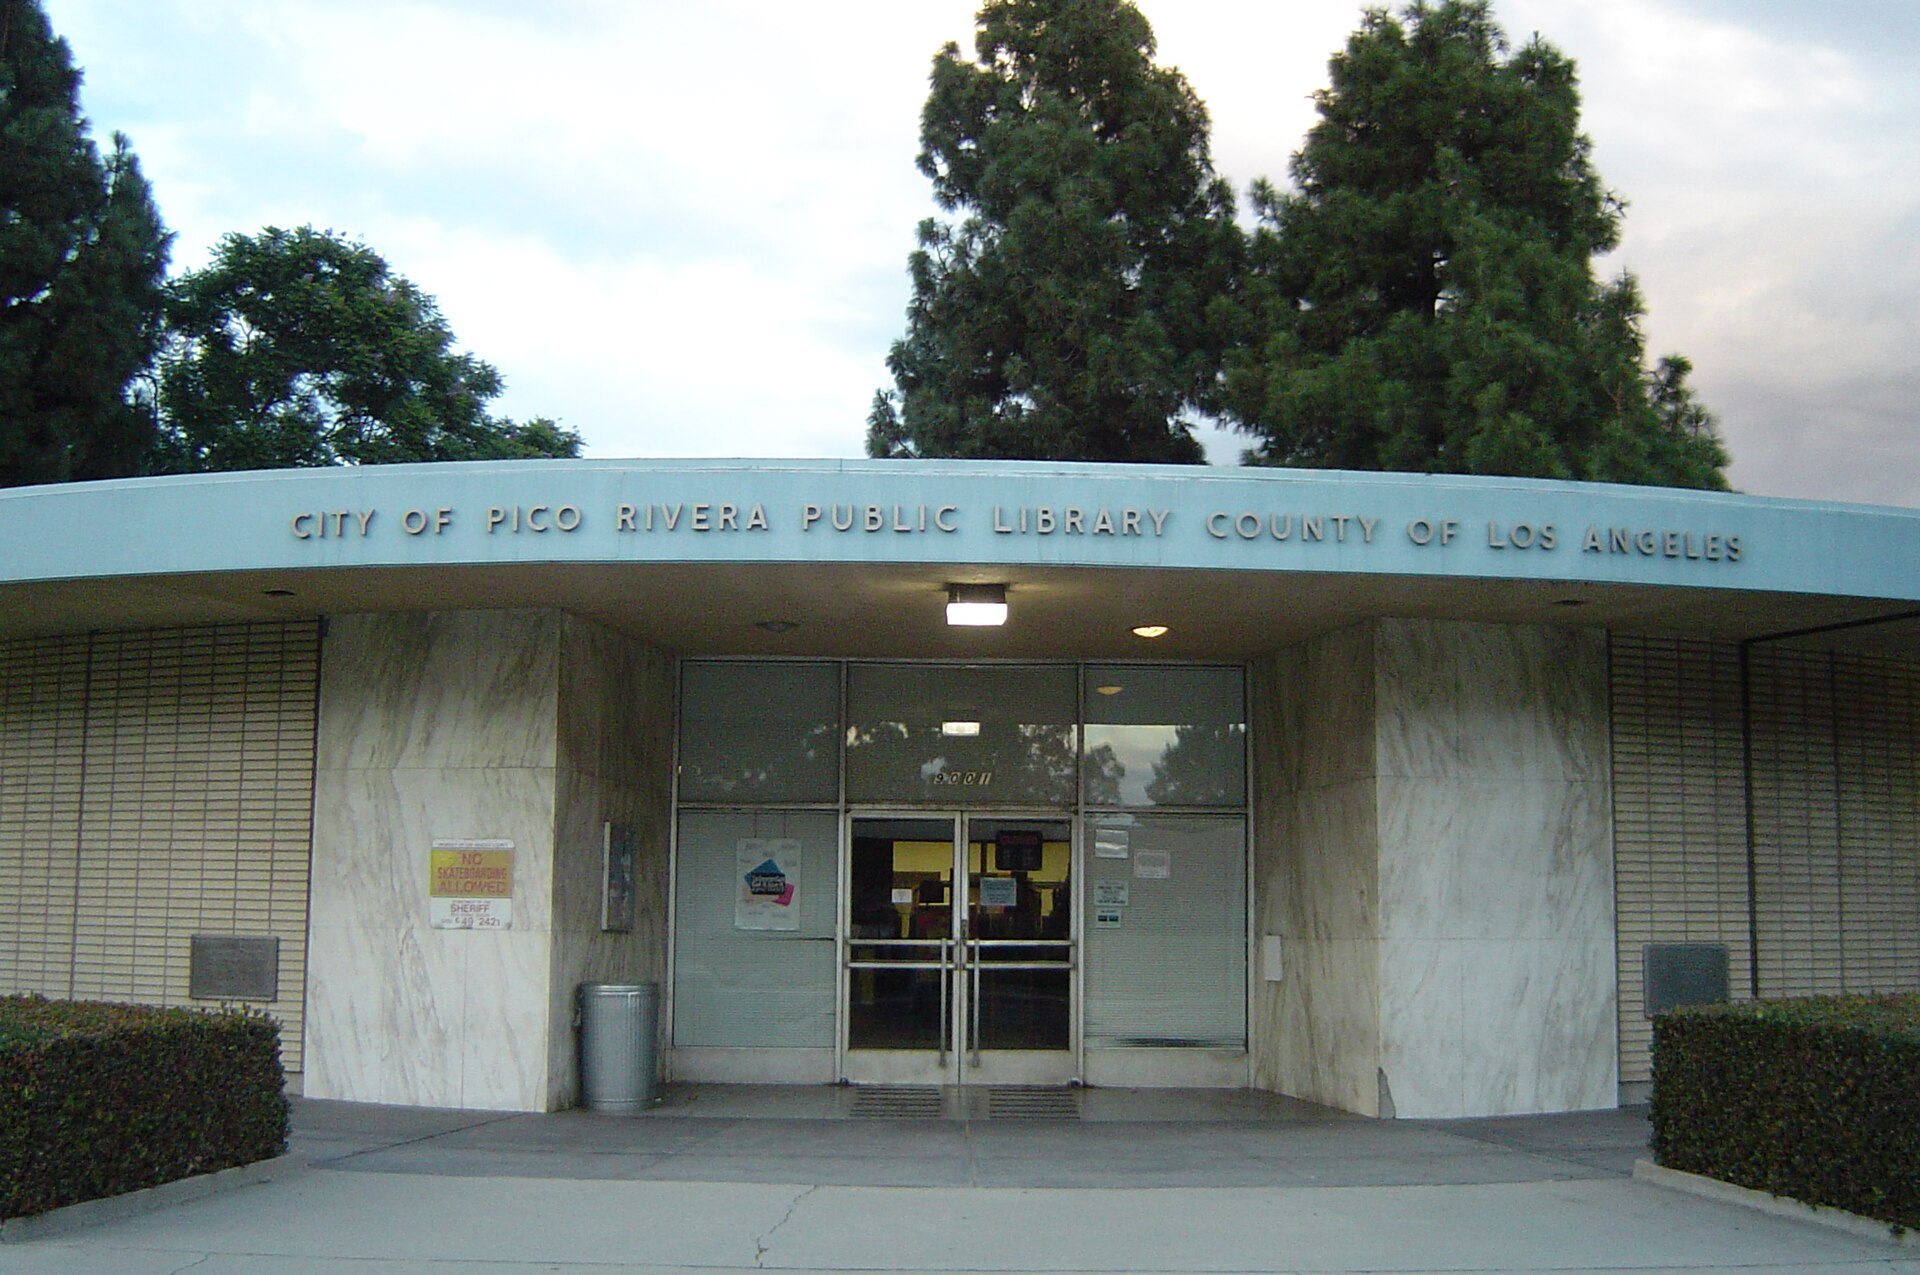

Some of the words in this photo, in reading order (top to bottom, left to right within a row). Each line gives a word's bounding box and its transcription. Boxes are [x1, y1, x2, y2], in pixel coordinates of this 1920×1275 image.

[291, 507, 376, 539] CITY
[402, 506, 453, 535] OF
[486, 503, 583, 534] PICO
[616, 502, 769, 532] RIVERA
[802, 503, 959, 533] PUBLIC
[993, 504, 1170, 536] LIBRARY
[1205, 510, 1380, 544] COUNTY
[1407, 518, 1459, 546] OF
[1487, 521, 1557, 550] LOS
[1583, 526, 1743, 562] ANGELES
[934, 771, 992, 785] 9001
[461, 852, 483, 865] NO
[437, 867, 507, 880] SKATEBOARDING
[437, 880, 506, 893] ALLOWED
[450, 903, 491, 913] SHERIFF
